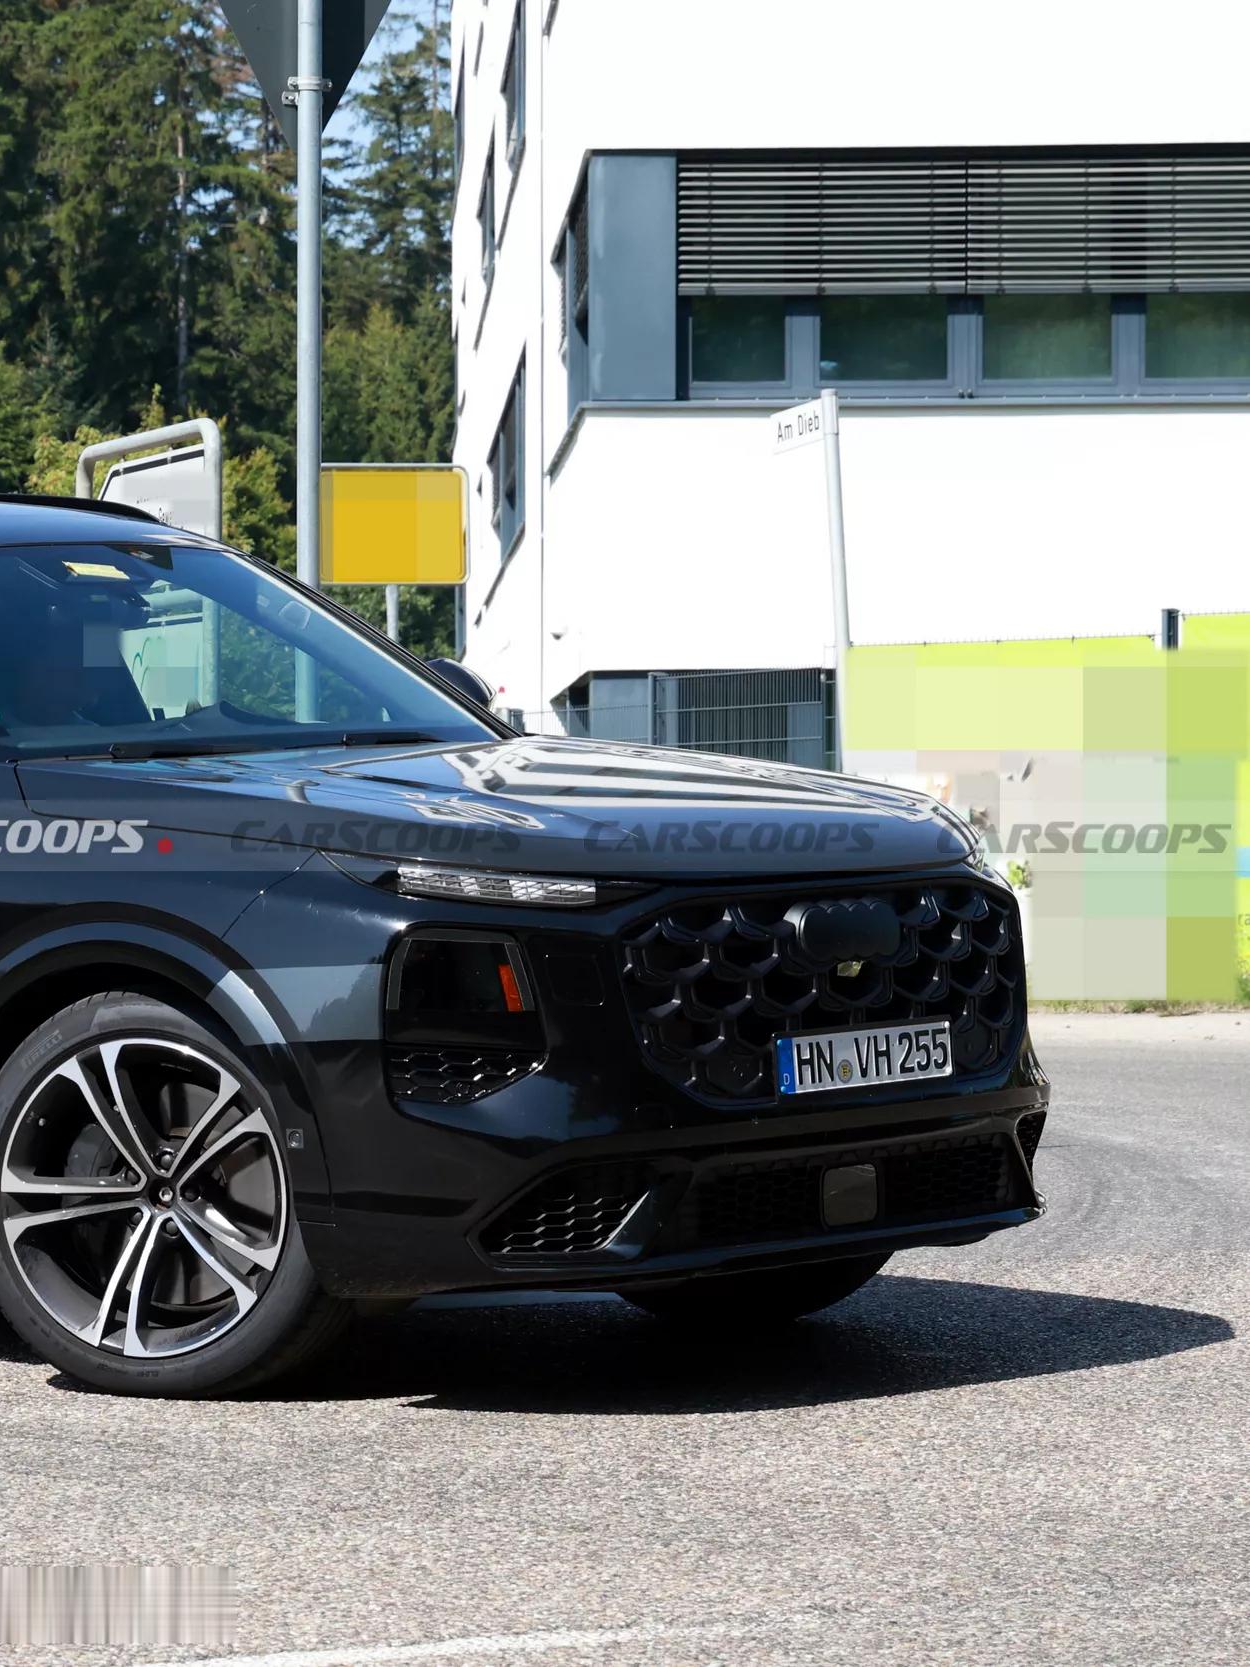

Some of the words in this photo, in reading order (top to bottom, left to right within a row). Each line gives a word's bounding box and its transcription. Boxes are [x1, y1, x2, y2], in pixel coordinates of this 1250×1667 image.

[777, 422, 793, 444] Am
[798, 410, 820, 436] Dieb
[795, 1040, 834, 1085] HN
[854, 1034, 892, 1078] VH
[898, 1028, 947, 1074] 255
